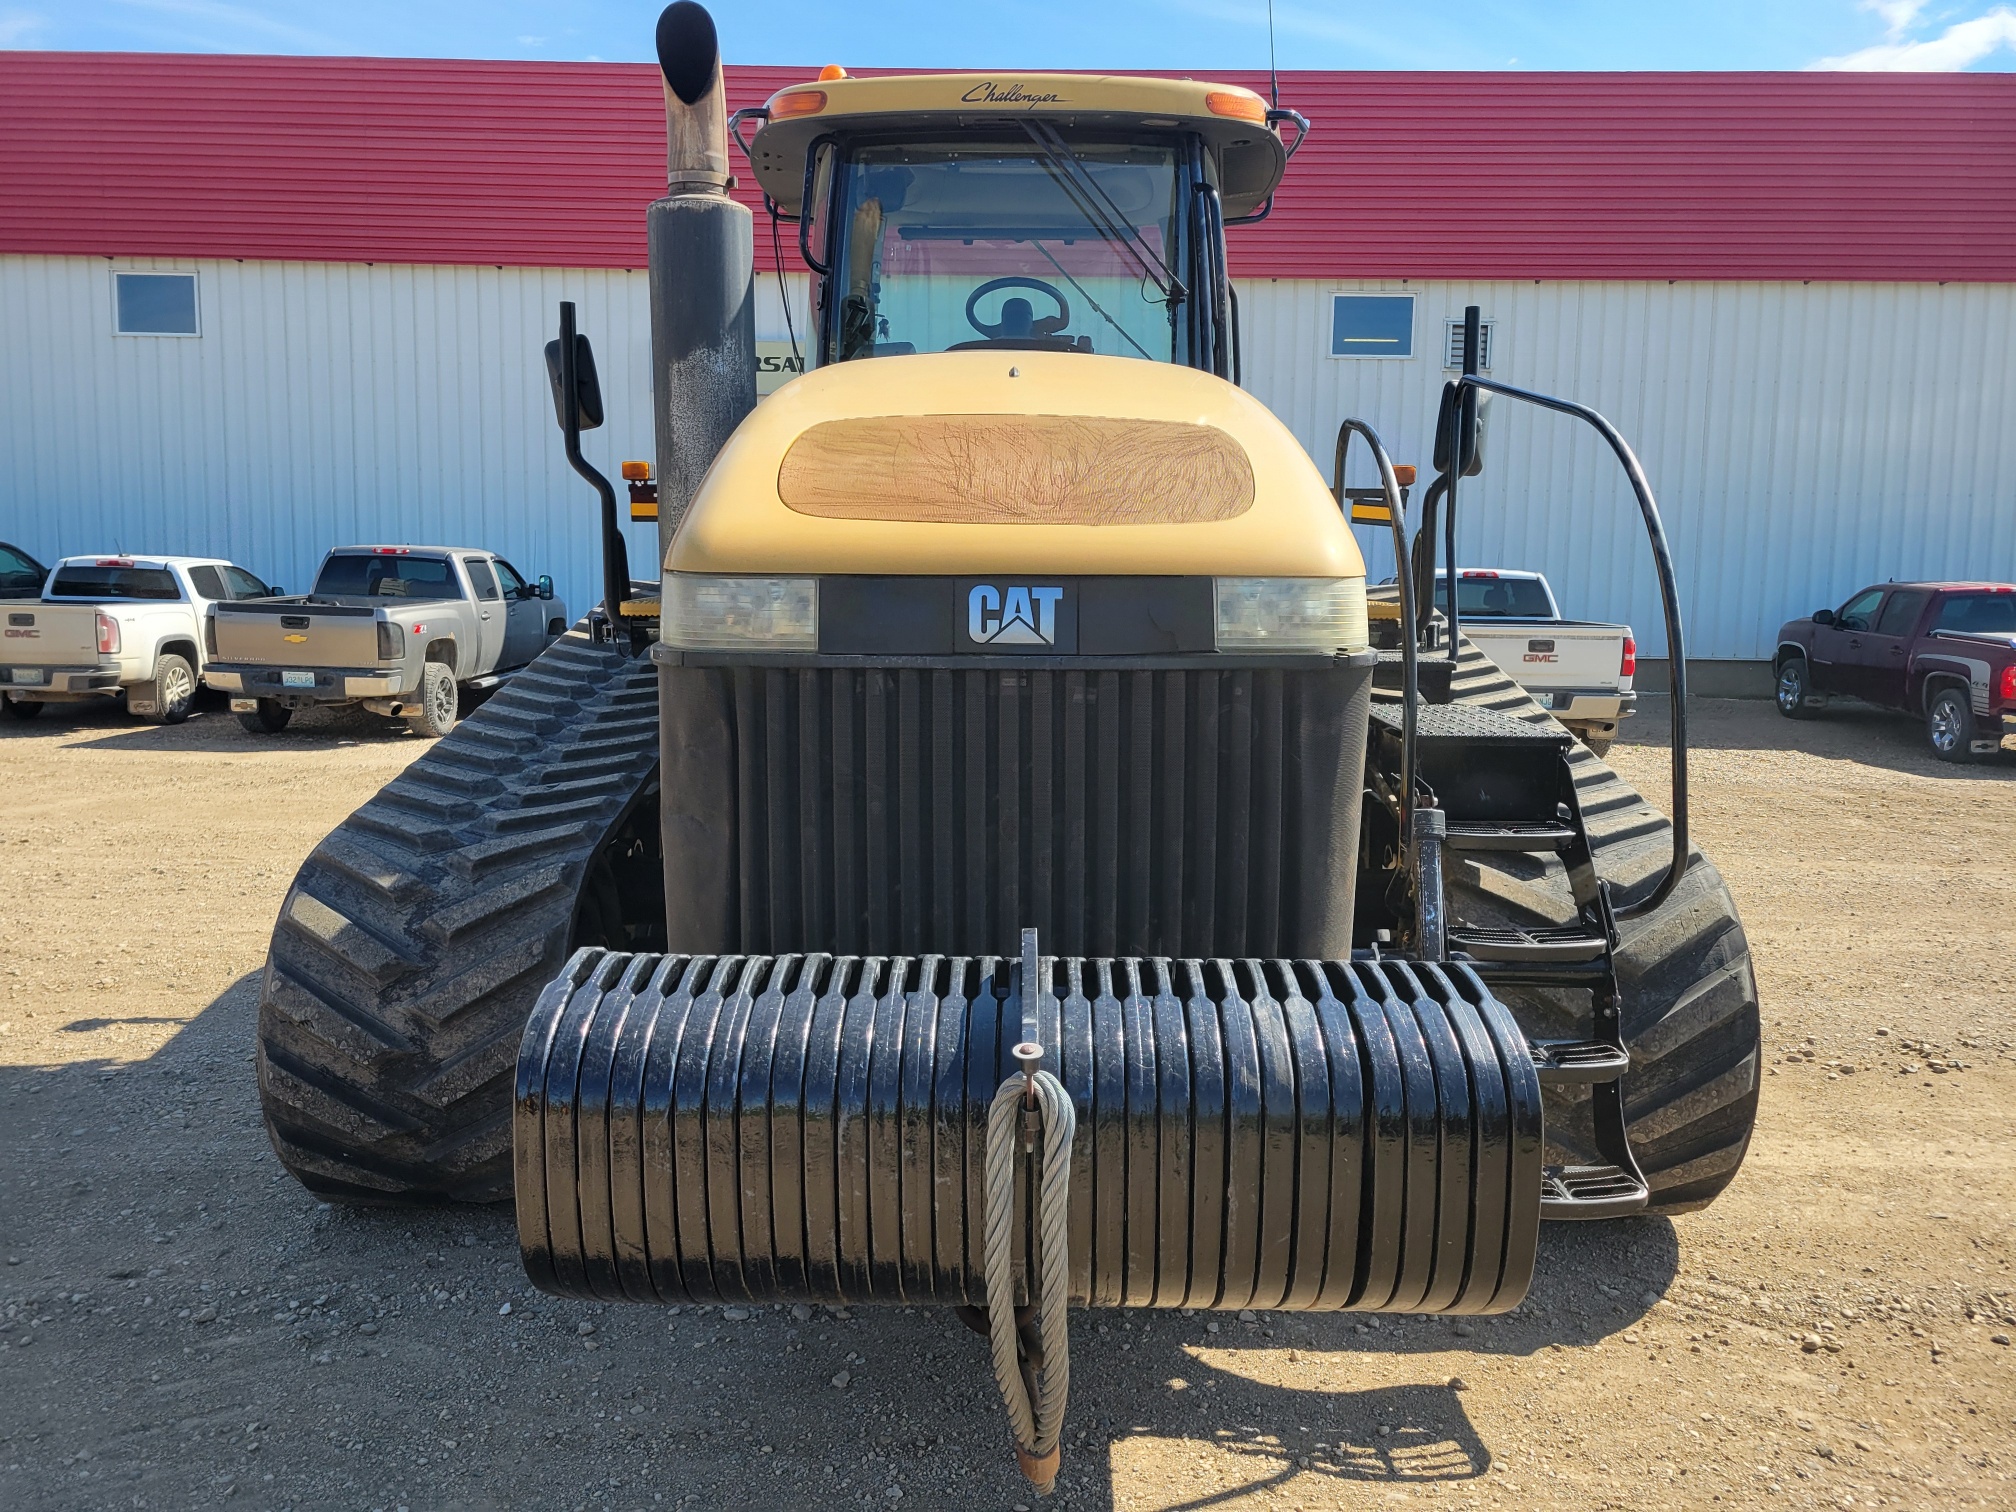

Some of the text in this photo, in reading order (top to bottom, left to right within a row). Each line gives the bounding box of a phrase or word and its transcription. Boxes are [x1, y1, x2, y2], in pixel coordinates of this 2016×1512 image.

[961, 82, 1074, 110] Challenger
[968, 585, 1064, 646] CAT
[4, 629, 41, 638] GMC
[1523, 654, 1559, 662] GMC
